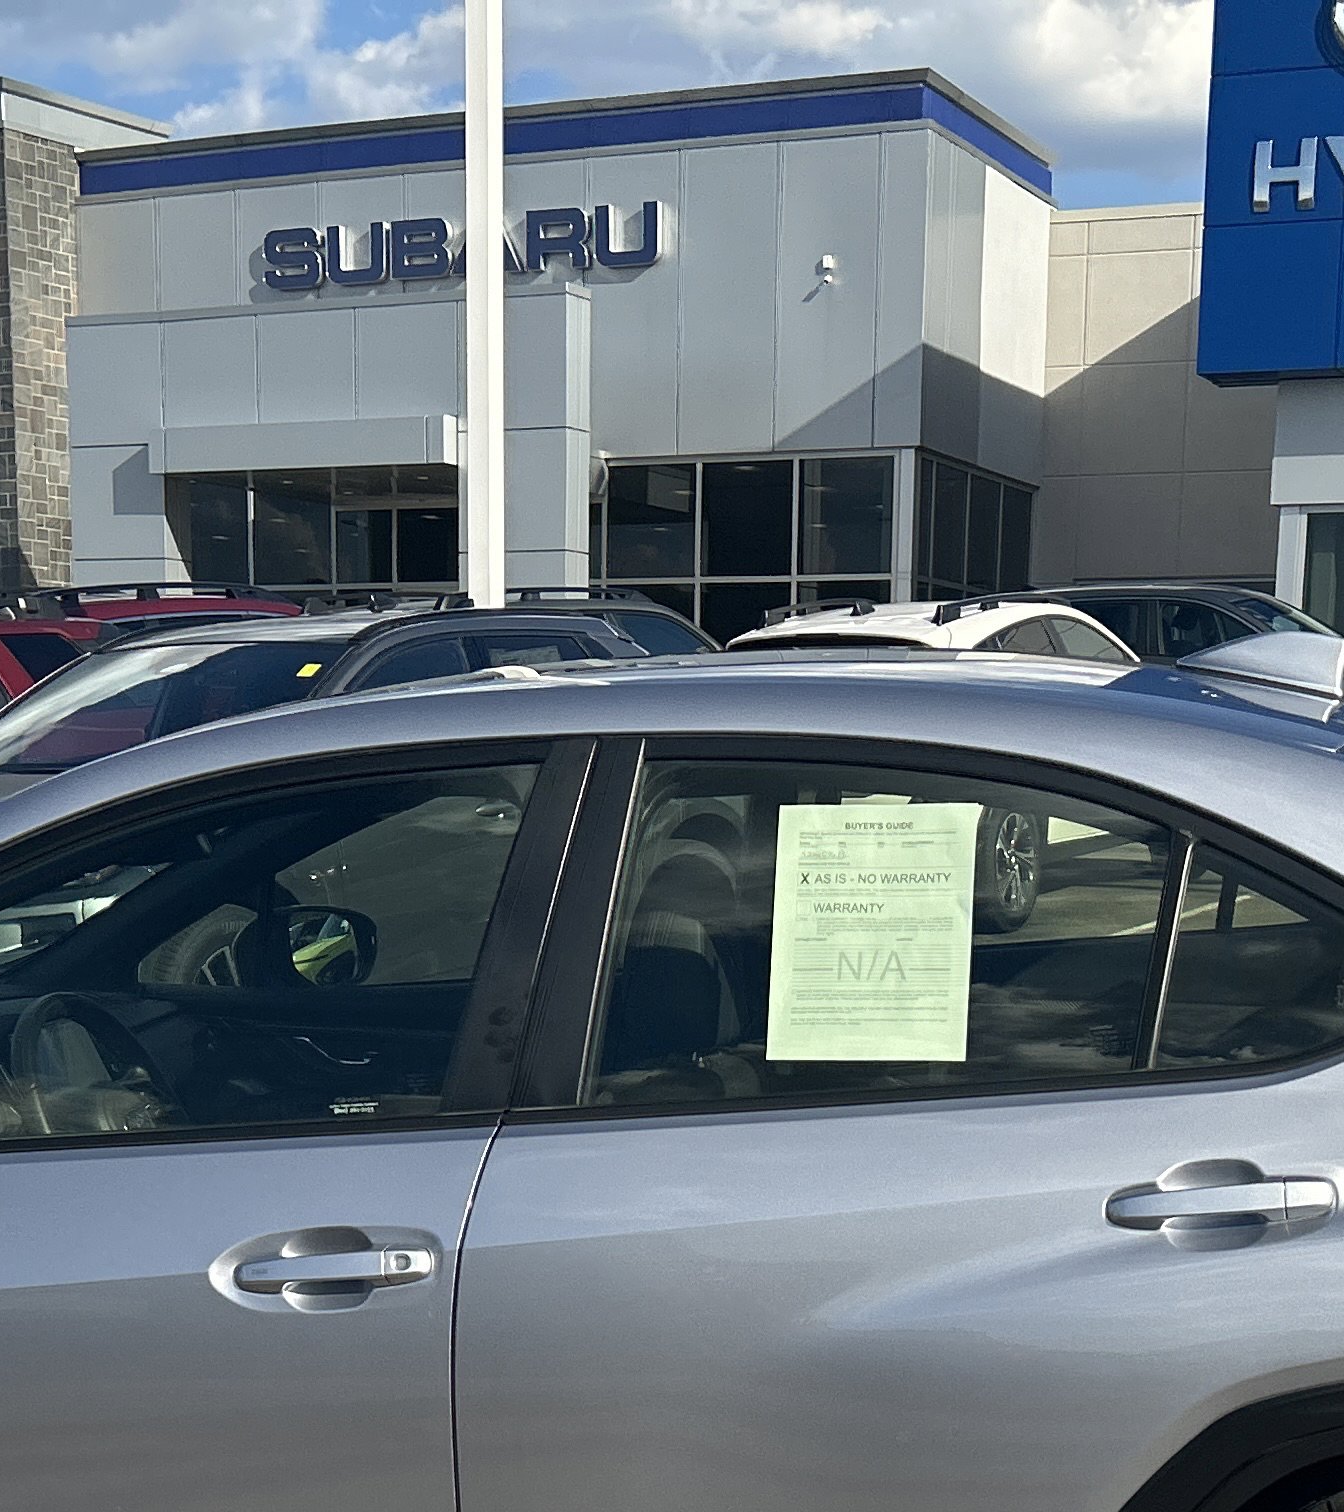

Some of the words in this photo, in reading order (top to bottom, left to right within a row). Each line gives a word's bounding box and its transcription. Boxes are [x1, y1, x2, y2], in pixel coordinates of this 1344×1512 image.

[844, 821, 884, 831] BUYER'S
[885, 821, 914, 831] GUIDE
[799, 872, 810, 885] X
[814, 873, 832, 885] AS
[835, 873, 847, 884] IS
[857, 873, 877, 884] NO
[880, 872, 952, 884] WARRANTY
[813, 902, 885, 914] WARRANTY
[836, 949, 907, 981] N/A
